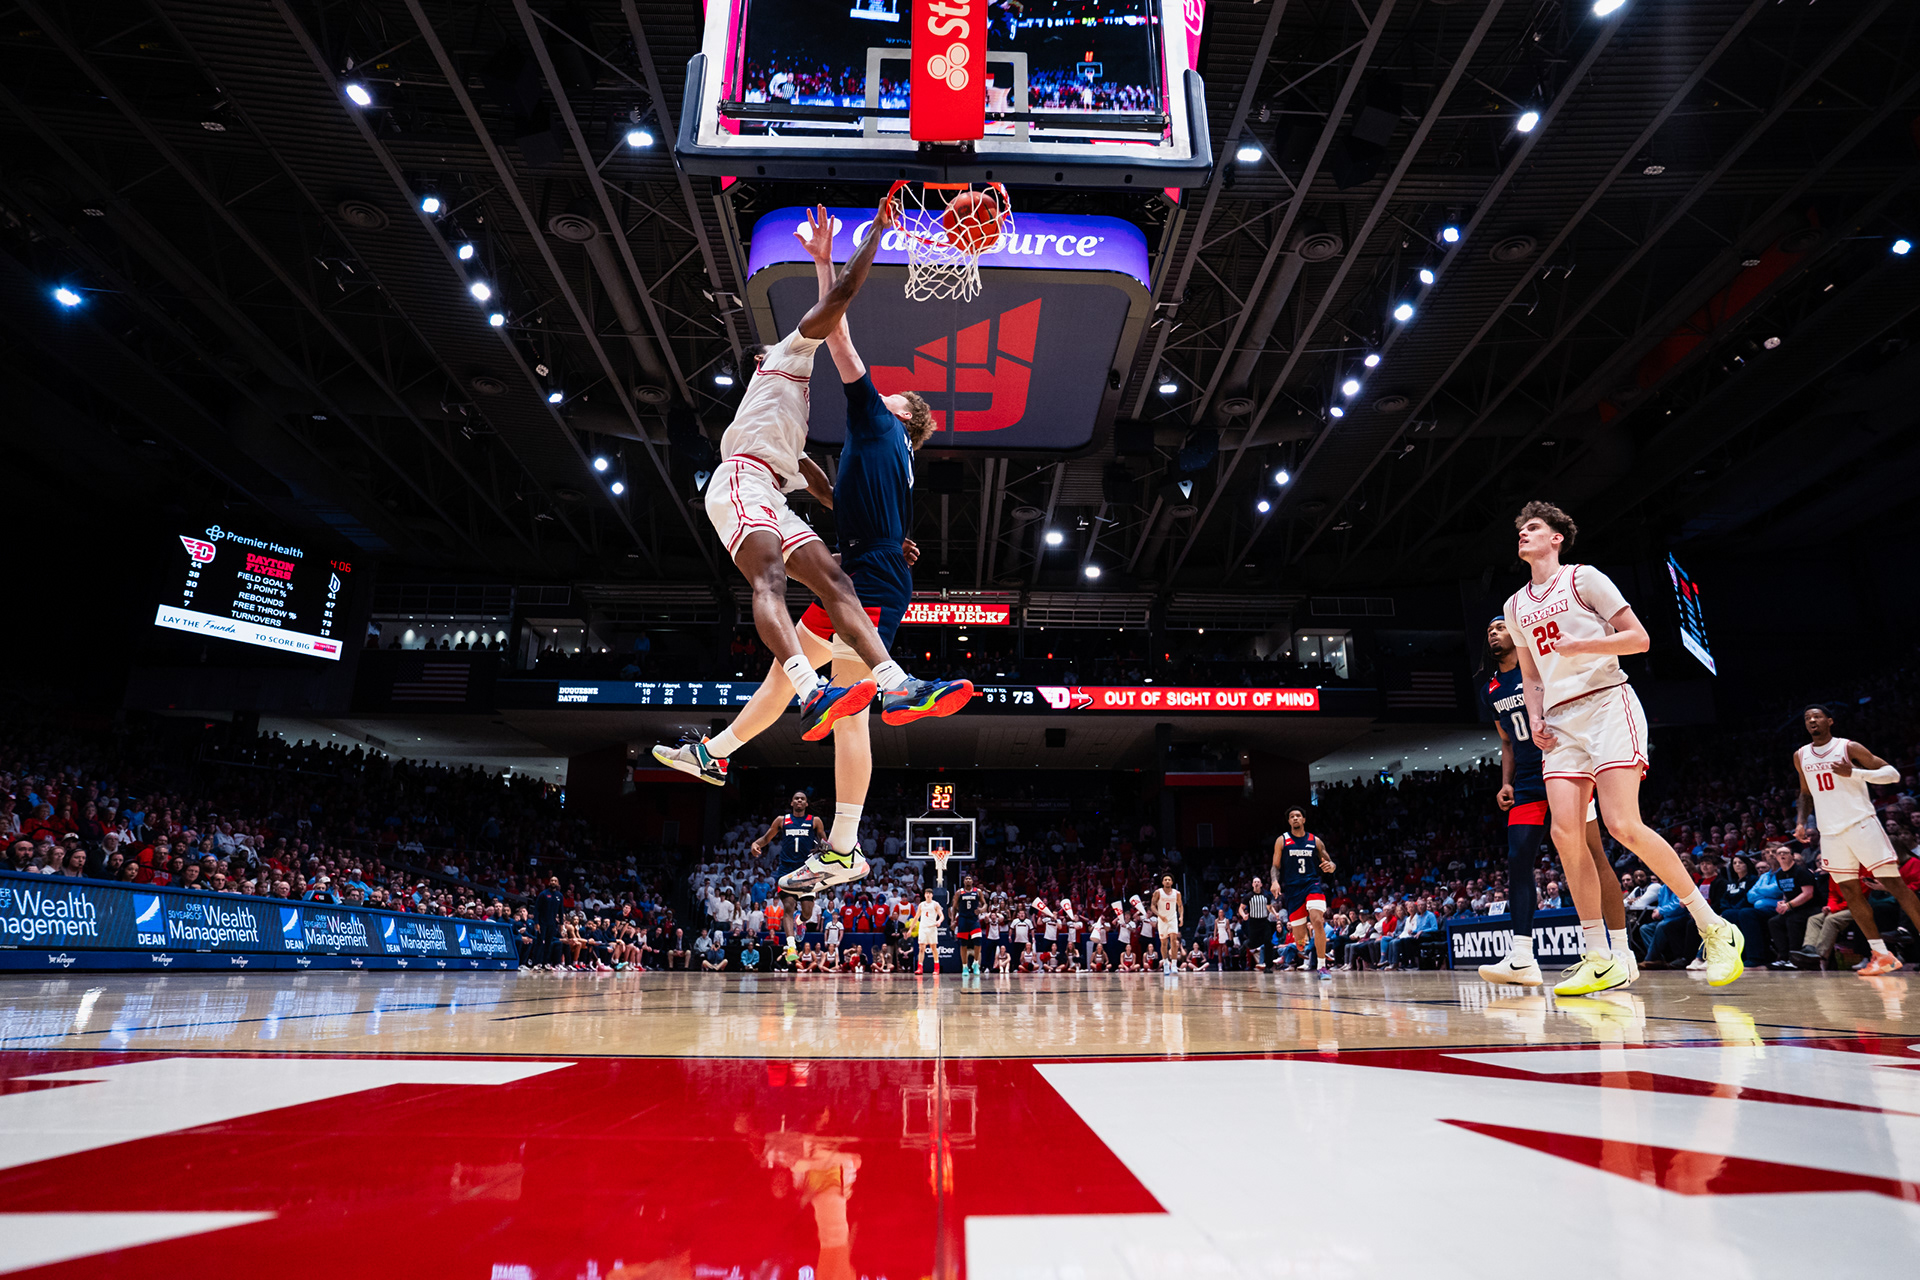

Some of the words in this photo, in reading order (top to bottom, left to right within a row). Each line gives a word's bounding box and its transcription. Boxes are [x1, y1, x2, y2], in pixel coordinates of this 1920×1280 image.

[927, 0, 970, 39] St
[852, 219, 1099, 257] Careource
[226, 531, 268, 549] Premier
[269, 542, 304, 559] Health
[190, 561, 202, 569] 44
[245, 562, 292, 580] FLYERS
[246, 553, 295, 572] DAYTON
[185, 580, 198, 588] 30
[237, 571, 261, 583] FIELD
[262, 577, 285, 589] GOAL
[286, 582, 294, 591] %
[246, 582, 252, 590] 3
[253, 584, 279, 595] POINT
[279, 590, 287, 598] %
[327, 592, 337, 600] 41
[238, 591, 284, 608] REBOUNDS
[907, 603, 930, 612] THE
[934, 604, 982, 613] CONNOR
[232, 600, 256, 612] FREE
[256, 605, 288, 618] THROW
[900, 610, 951, 623] LIGHT
[953, 611, 998, 624] DECK
[1520, 599, 1569, 629] DAYTON
[231, 610, 282, 627] TURNOVERS
[163, 615, 181, 624] LAY
[183, 619, 200, 629] THE
[256, 633, 267, 641] TO
[268, 636, 294, 647] SCORE
[296, 642, 310, 650] BIG
[1532, 620, 1561, 656] 29
[558, 686, 599, 695] DUQUESNE
[664, 688, 674, 696] 22
[692, 688, 698, 696] 3
[719, 688, 729, 696] 12
[987, 693, 994, 703] 9
[1000, 693, 1007, 703] 3
[1012, 691, 1034, 704] 73
[1104, 691, 1135, 705] OUT
[1140, 691, 1161, 705] OF
[1166, 691, 1211, 706] SIGHT
[1215, 692, 1248, 706] OUT
[1252, 693, 1272, 706] OF
[1276, 693, 1315, 706] MIND
[557, 694, 589, 703] DAYTON
[641, 696, 651, 704] 21
[691, 697, 698, 705] 5
[718, 698, 728, 706] 13
[1493, 693, 1525, 714] DUQUES
[1510, 710, 1530, 742] 0
[1804, 761, 1834, 773] DAYT
[1816, 772, 1835, 792] 10
[932, 793, 950, 809] 22
[794, 837, 800, 853] 1
[1298, 858, 1306, 874] 3
[0, 887, 12, 898] ER
[13, 888, 96, 919] Wealth
[185, 903, 202, 912] OVER
[1165, 902, 1171, 911] 0
[168, 910, 175, 918] 50
[175, 911, 194, 919] YEARS
[194, 912, 203, 920] OF
[202, 904, 257, 928] Wealth
[0, 916, 99, 941] nagement
[168, 919, 260, 946] Management
[326, 915, 366, 935] Wealth
[415, 923, 446, 940] Wealth
[137, 933, 166, 946] DEAN
[284, 939, 304, 950] DEAN
[304, 927, 369, 950] Management
[399, 934, 448, 954] Management
[481, 929, 506, 943] Wealth
[1452, 929, 1515, 958] DAYTON
[386, 943, 401, 953] DEAN
[470, 939, 508, 956] Management
[56, 952, 76, 968] Kroger
[157, 953, 174, 967] Kroger
